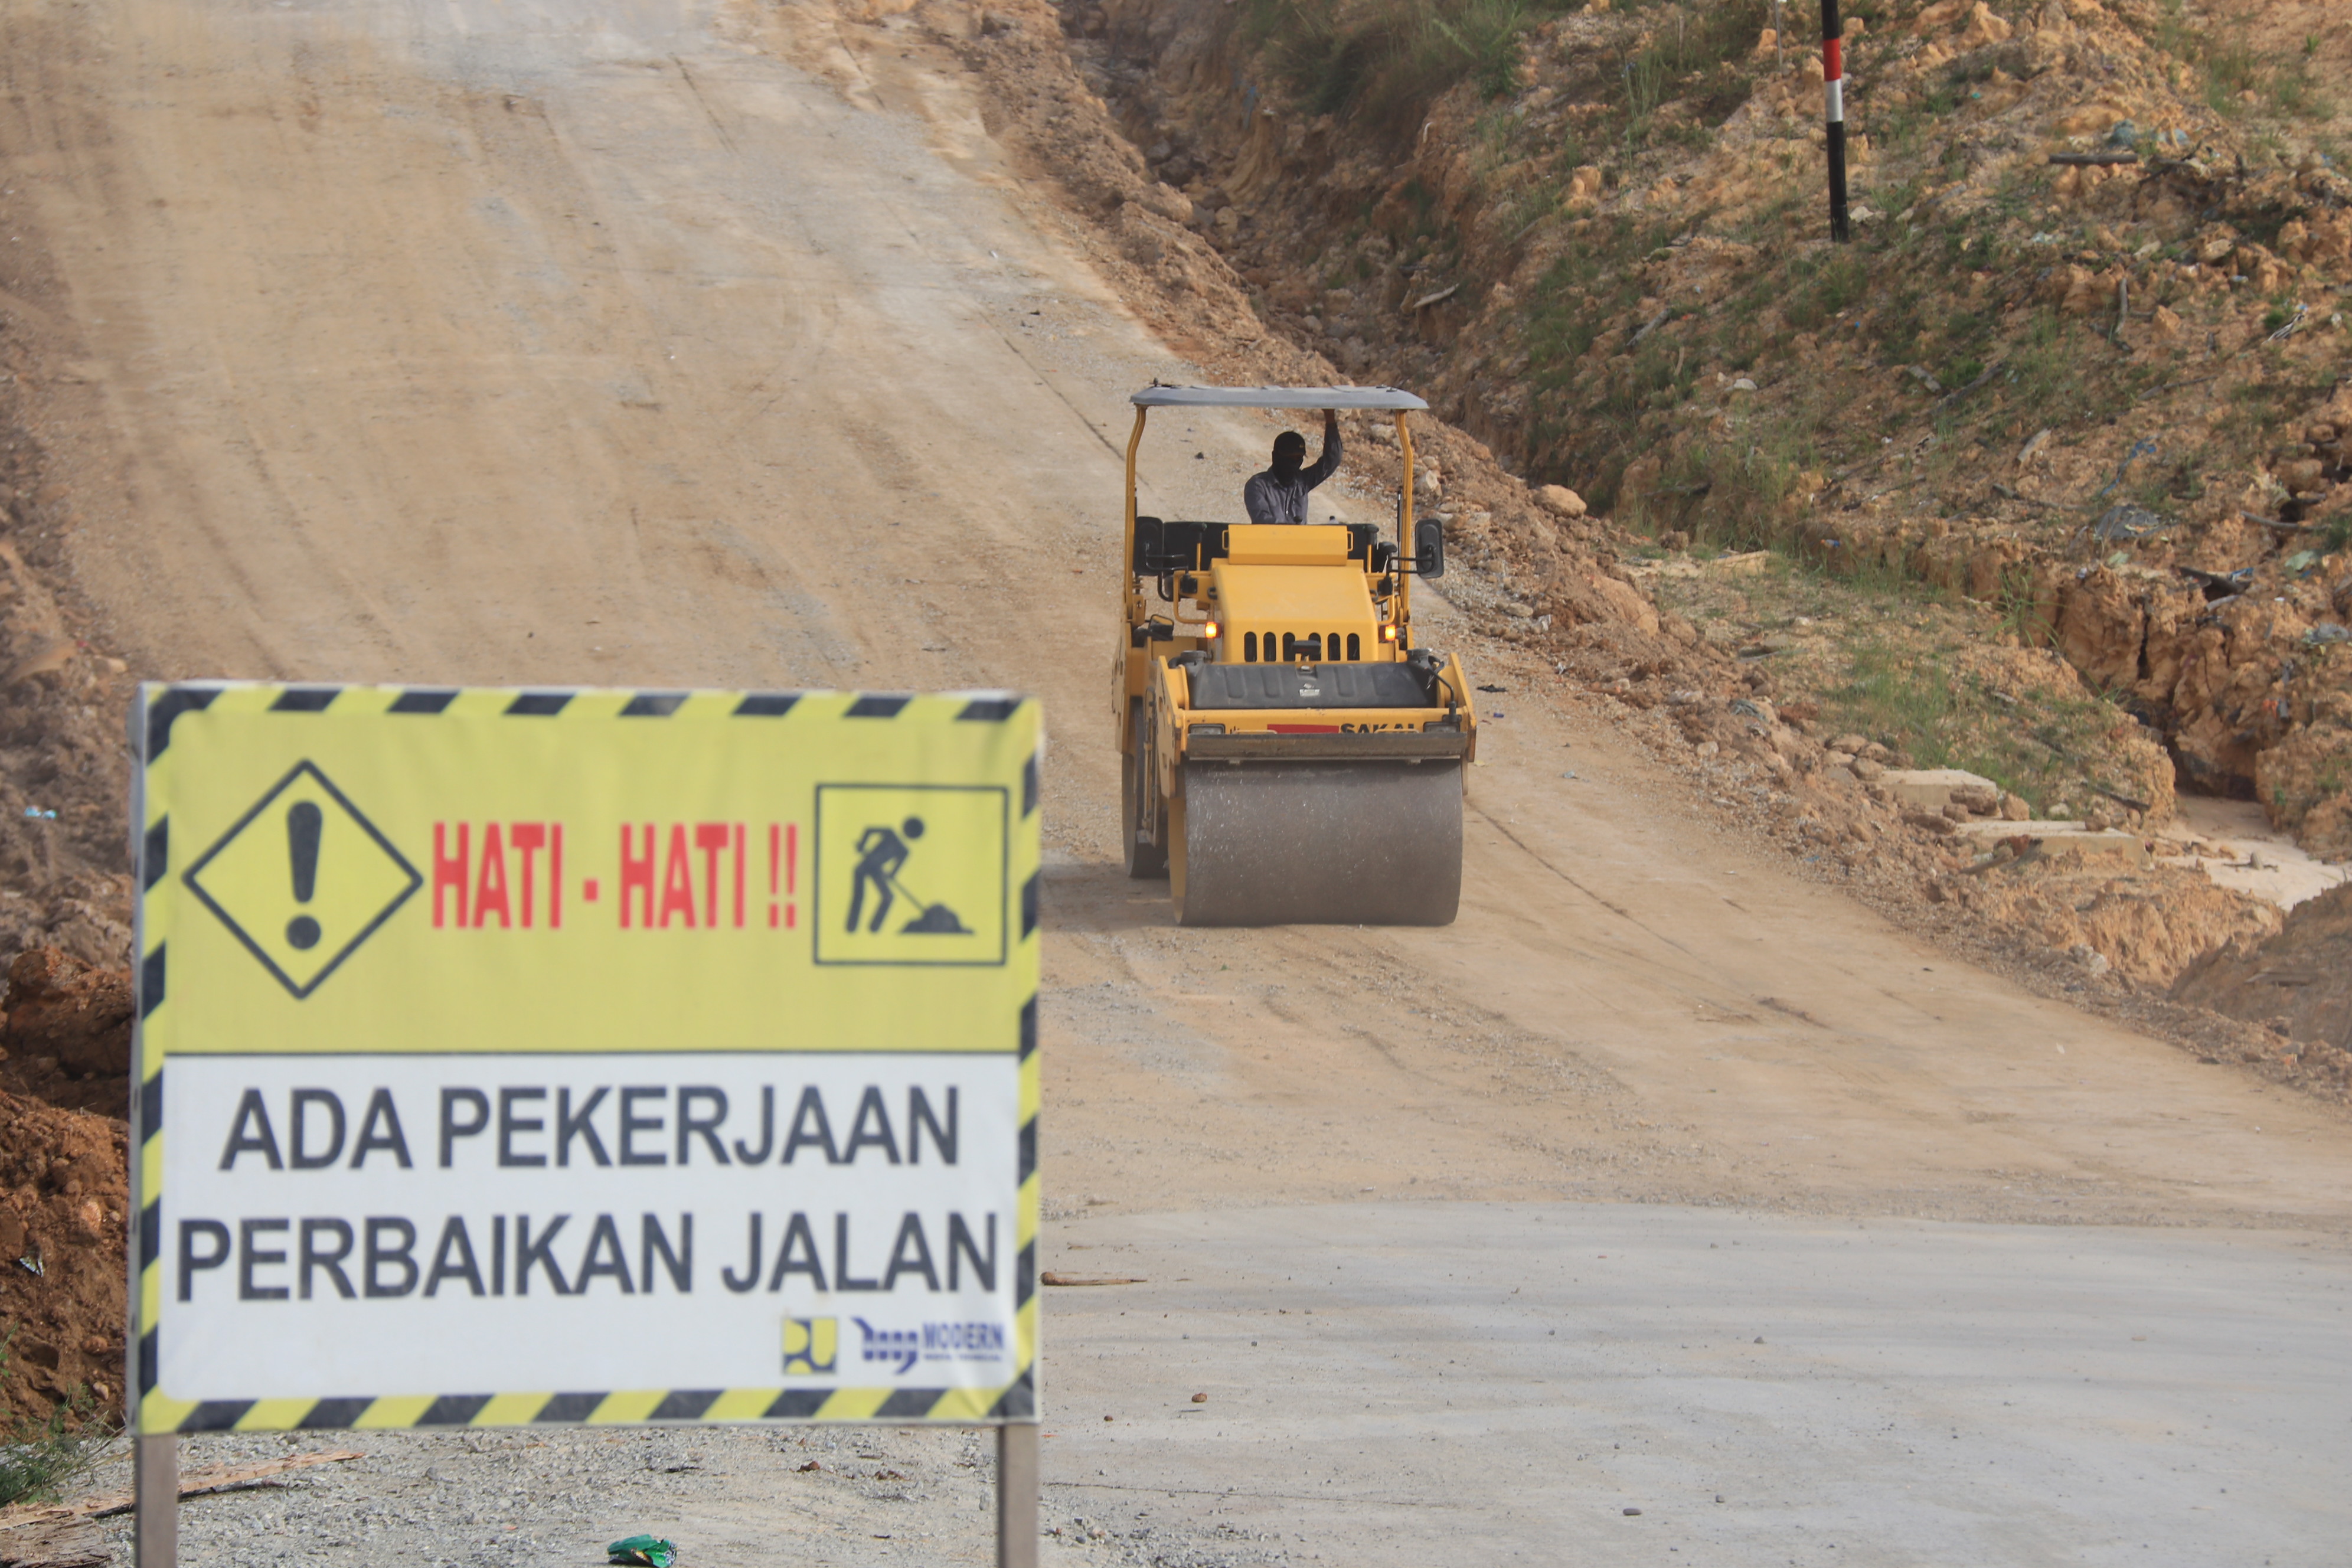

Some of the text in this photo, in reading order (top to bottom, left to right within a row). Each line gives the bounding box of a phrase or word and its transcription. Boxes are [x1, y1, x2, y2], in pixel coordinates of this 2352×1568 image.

[433, 822, 563, 929] HATI
[620, 823, 746, 929] HATI
[769, 824, 797, 929] !!
[220, 1086, 957, 1170] ADA PEKERJAAN
[178, 1212, 995, 1302] PERBAIKAN JALAN
